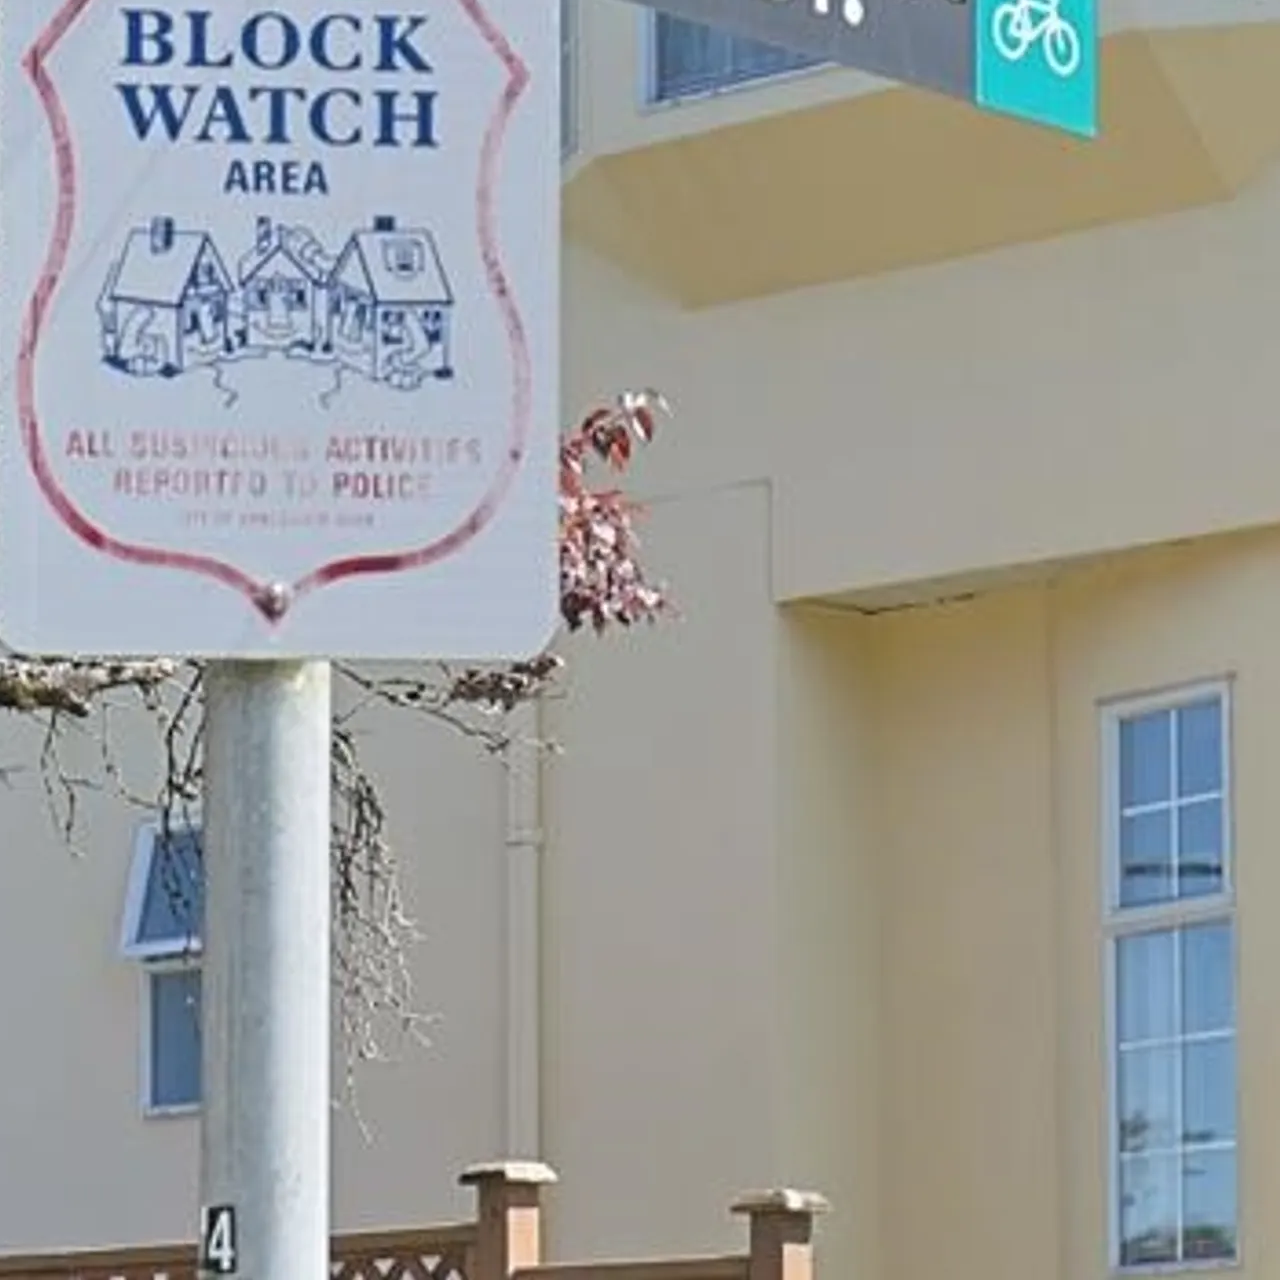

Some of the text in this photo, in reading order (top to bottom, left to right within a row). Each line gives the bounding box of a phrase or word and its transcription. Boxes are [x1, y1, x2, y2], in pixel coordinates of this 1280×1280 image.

[120, 7, 434, 74] BLOCK
[116, 82, 439, 149] WATCH
[223, 159, 329, 196] AREA
[65, 429, 115, 459] ALL
[130, 430, 310, 462] SUSICIO
[208, 1209, 235, 1271] 4
